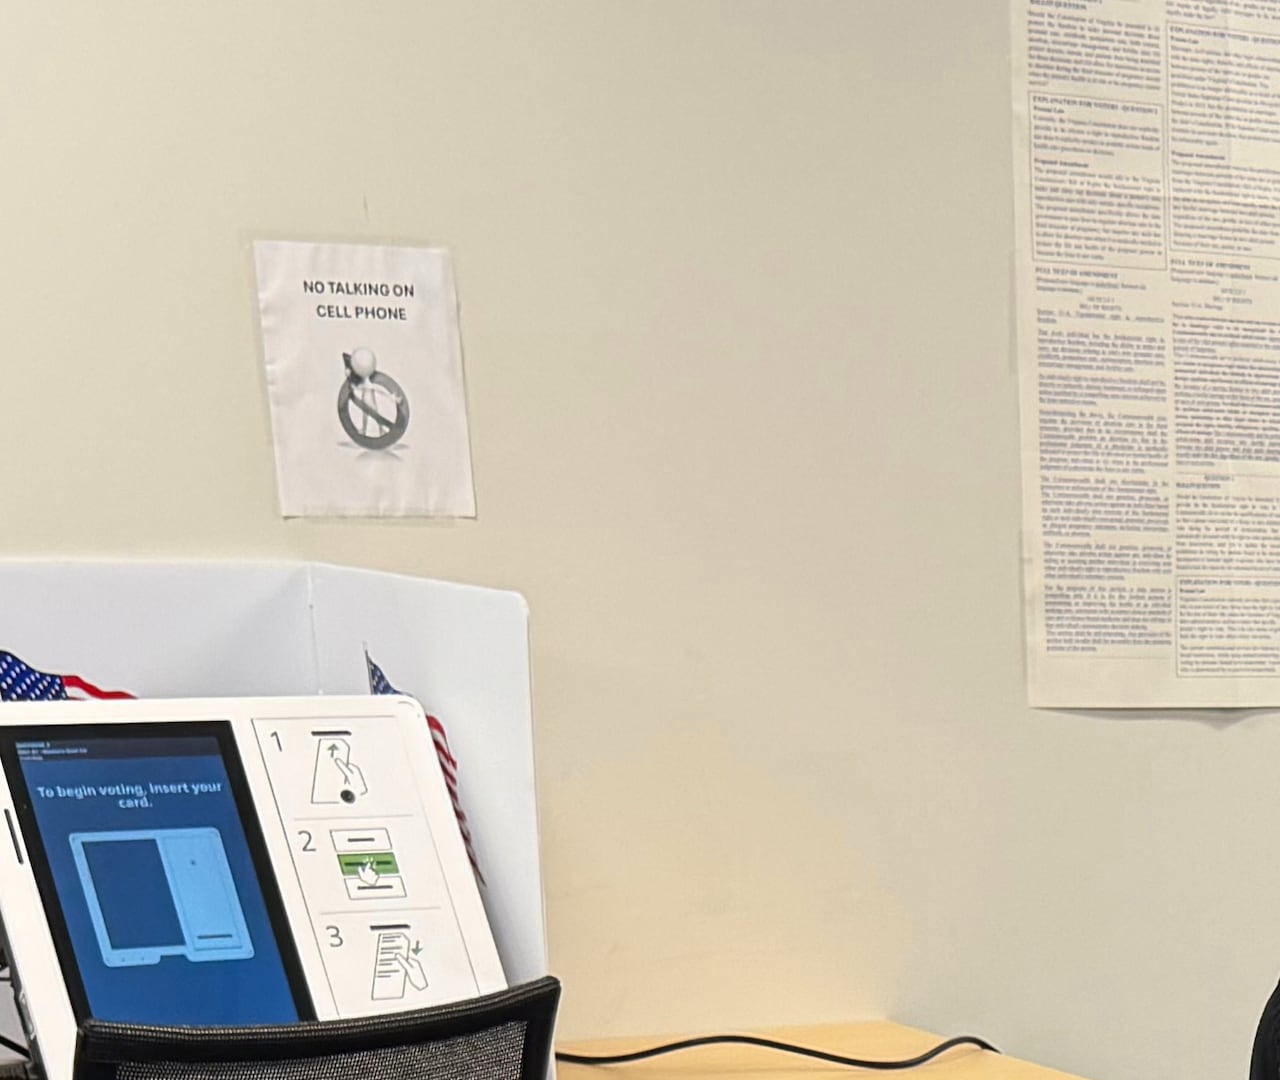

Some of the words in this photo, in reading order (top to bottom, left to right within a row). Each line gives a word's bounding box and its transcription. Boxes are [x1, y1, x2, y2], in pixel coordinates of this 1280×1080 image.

[304, 280, 324, 294] NO
[330, 282, 390, 297] TALKING
[393, 284, 414, 298] ON
[316, 304, 351, 318] CELL
[355, 306, 406, 320] PHONE
[269, 731, 284, 752] 1
[37, 785, 52, 797] To
[56, 784, 97, 803] begin
[100, 783, 146, 799] voting,
[149, 781, 189, 795] insert
[192, 781, 222, 796] your
[119, 796, 152, 809] card.
[297, 830, 316, 852] 2
[325, 925, 344, 948] 3
